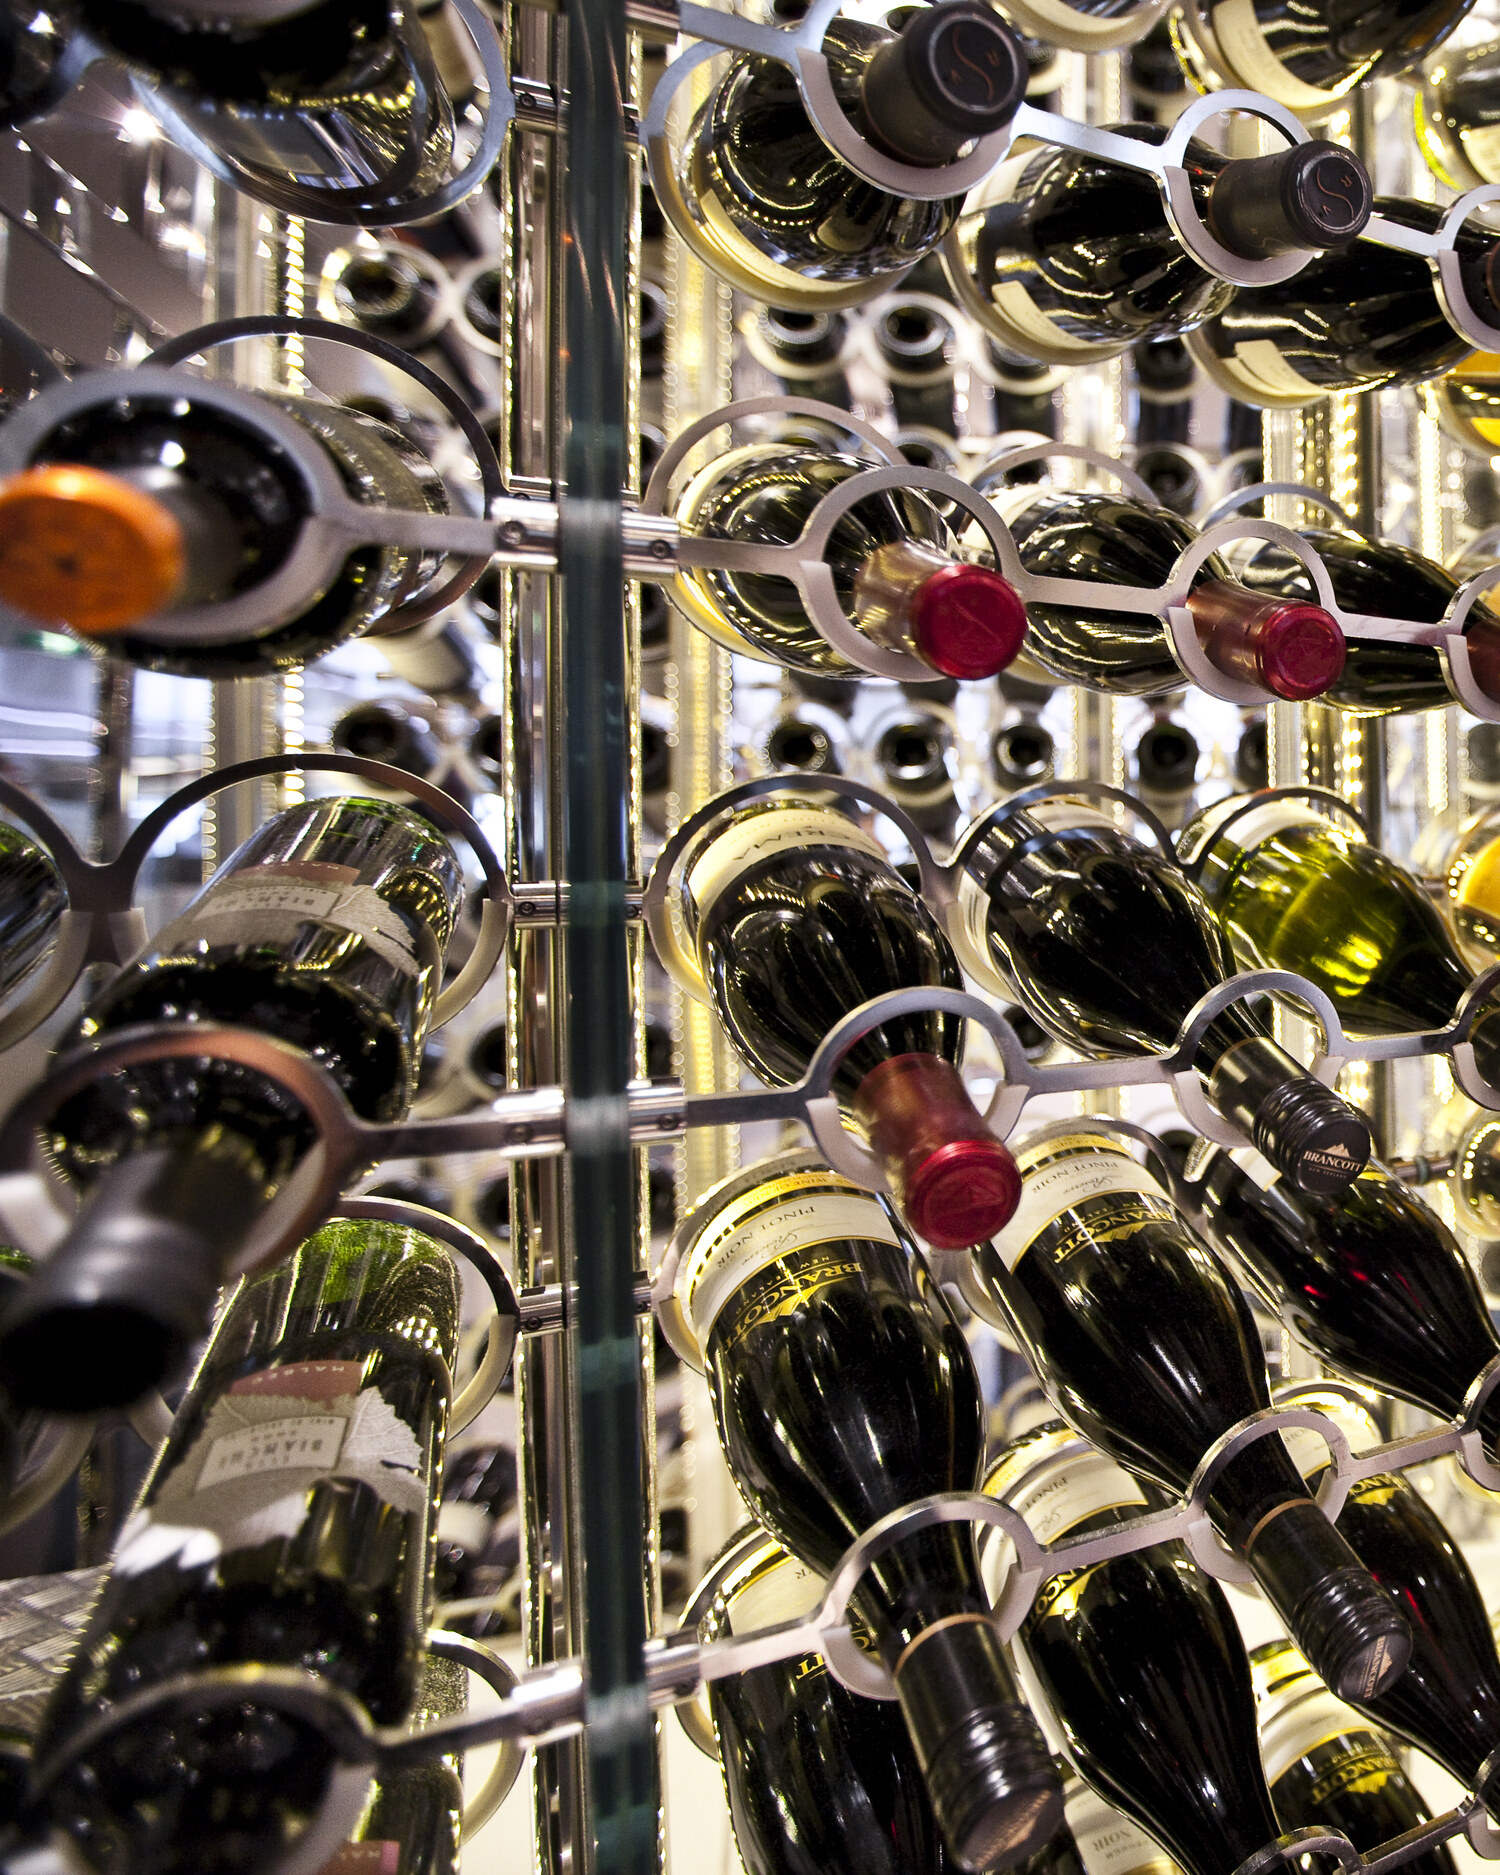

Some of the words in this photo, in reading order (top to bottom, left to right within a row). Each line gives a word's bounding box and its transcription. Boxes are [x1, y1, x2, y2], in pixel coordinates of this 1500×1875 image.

[1074, 1160, 1120, 1173] PINOT
[1303, 1150, 1362, 1172] BRANCOTT
[1032, 1167, 1070, 1195] NOIR
[760, 1206, 816, 1231] PINOT
[1054, 1209, 1174, 1264] BRANCOTT
[716, 1231, 754, 1269] NOIR
[799, 1255, 831, 1270] NEW
[725, 1261, 864, 1354] BRANCOTT
